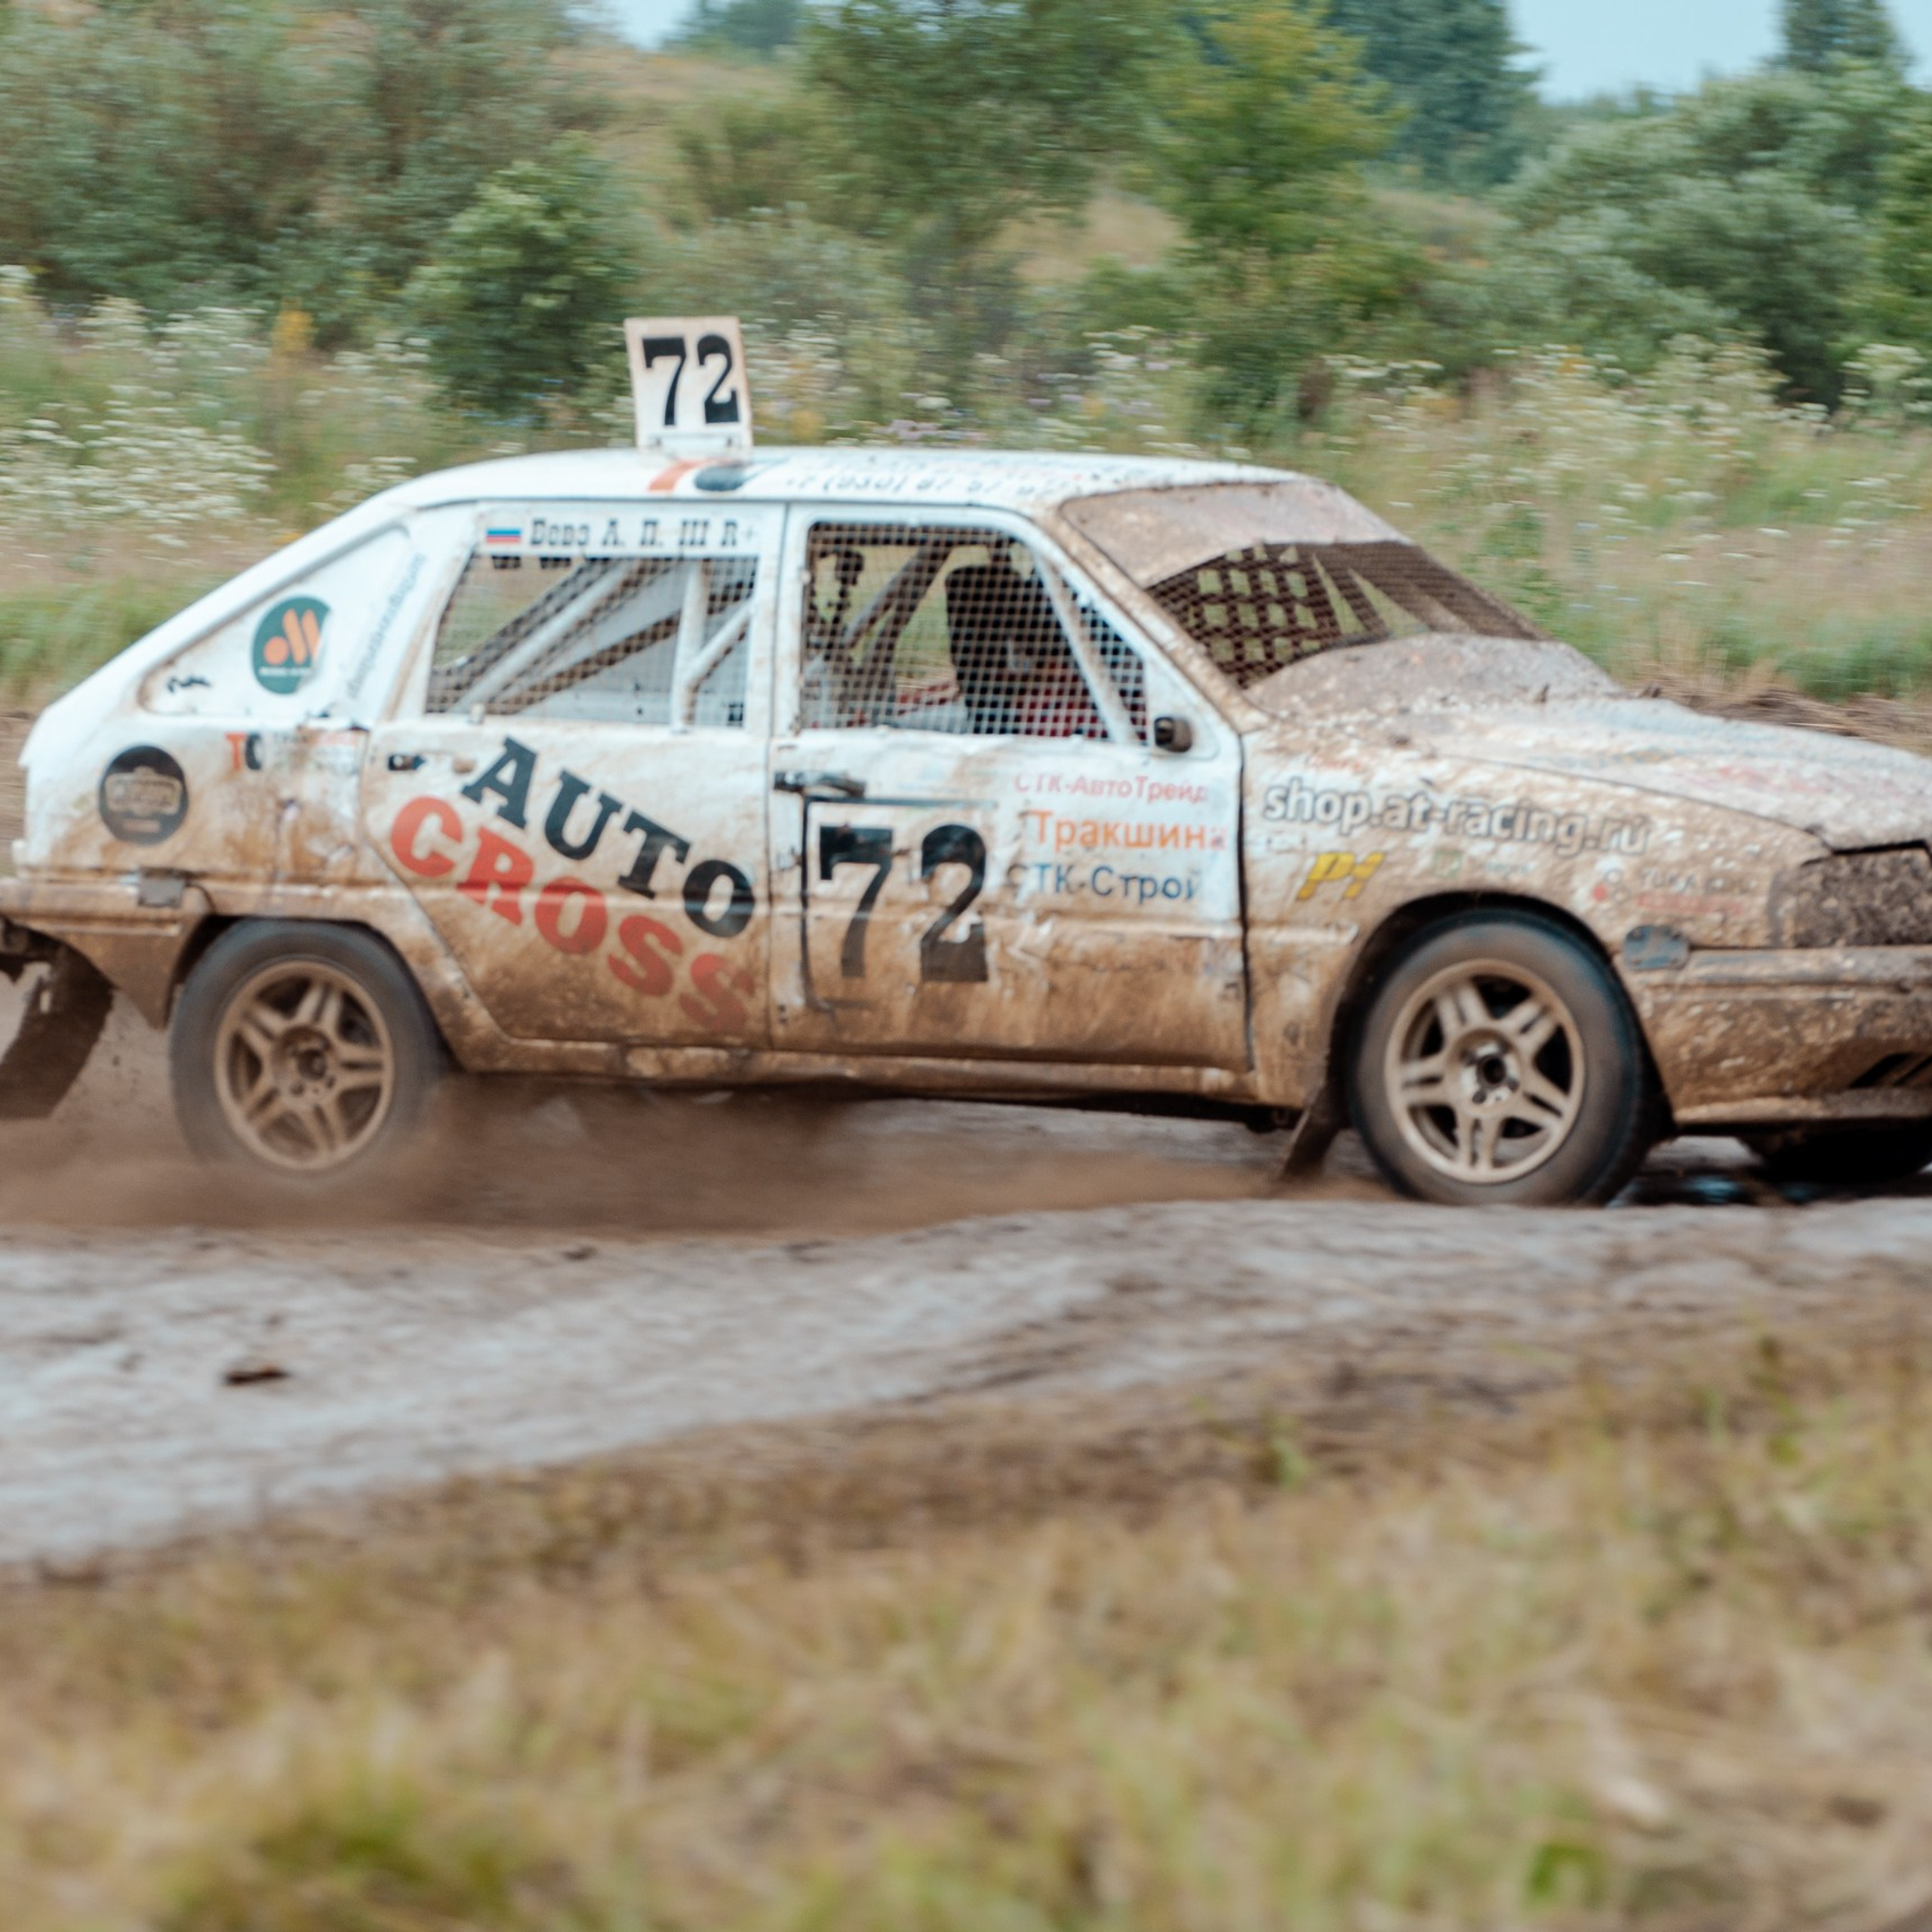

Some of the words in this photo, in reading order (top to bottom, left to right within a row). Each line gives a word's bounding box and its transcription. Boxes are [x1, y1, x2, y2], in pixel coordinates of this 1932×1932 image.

[642, 334, 740, 426] 72
[461, 737, 755, 938] AUTO
[1263, 776, 1651, 857] shop.at-racing.ru
[390, 795, 755, 1032] CROSS
[820, 824, 989, 983] 72
